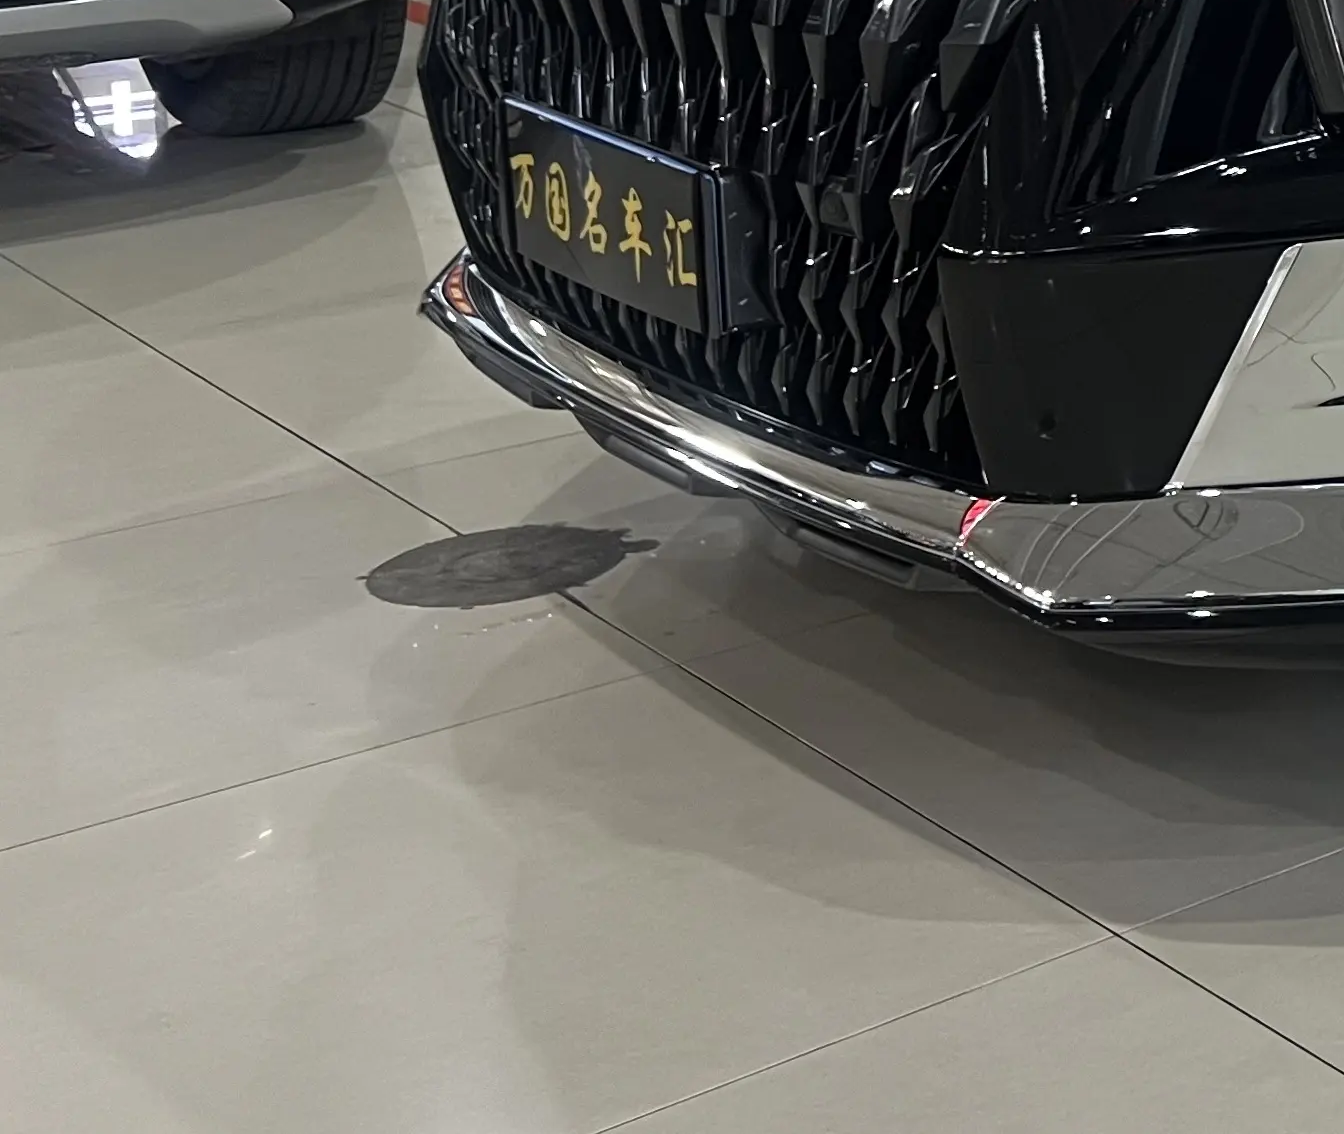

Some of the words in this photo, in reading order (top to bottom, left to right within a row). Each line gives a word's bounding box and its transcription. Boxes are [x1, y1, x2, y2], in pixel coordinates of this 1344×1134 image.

[510, 154, 698, 287] 万国名车汇
